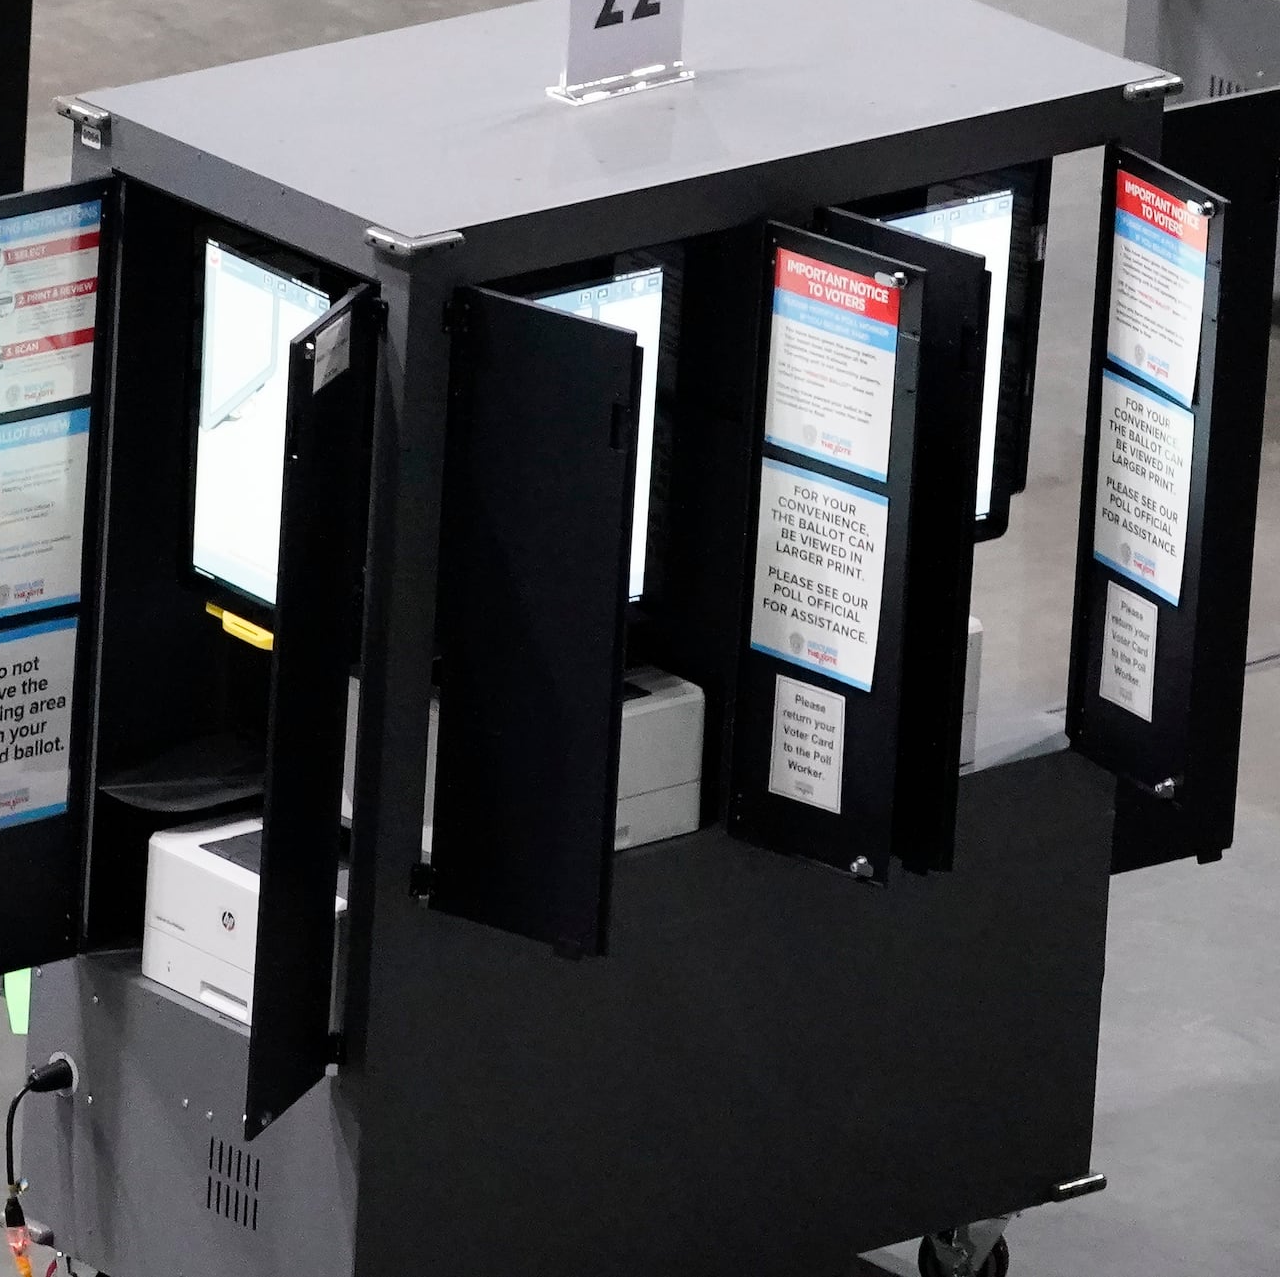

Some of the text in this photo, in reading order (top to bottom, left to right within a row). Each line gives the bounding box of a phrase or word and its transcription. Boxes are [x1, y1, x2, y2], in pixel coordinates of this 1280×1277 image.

[24, 206, 98, 233] INSTRUCTIONS
[1126, 181, 1200, 232] IMPORTANT NOTICE
[1142, 203, 1184, 238] TO VOTERS
[14, 246, 46, 261] SELECT
[27, 290, 51, 302] PRINT
[60, 281, 92, 296] REVIEW
[788, 260, 888, 303] IMPORTANT NOTICE
[808, 281, 865, 311] TO VOTERS
[15, 342, 39, 355] SCAN
[1126, 397, 1170, 428] FOR YOUR
[31, 419, 68, 437] REVIEW
[1109, 419, 1183, 468] THE BALLOT CAN
[1112, 451, 1146, 478] LARGER
[1116, 438, 1174, 478] BE VIEWED IN
[794, 485, 856, 516] FOR YOUR
[1106, 475, 1178, 524] PLEASE SEE OUR
[1110, 492, 1172, 537] POLL OFFICIAL
[771, 508, 874, 553] THE BALLOT CAN
[1102, 507, 1175, 557] FOR ASSISTANCE.
[781, 528, 862, 565] BE VIEWED IN
[776, 540, 864, 581] LARGER PRINT.
[768, 565, 868, 610] PLEASE SEE OUR
[774, 582, 860, 623] POLL OFFICIAL
[1121, 600, 1143, 621] Please
[763, 597, 865, 643] FOR ASSISTANCE.
[1112, 629, 1148, 658] Voter Card
[1135, 627, 1150, 643] your
[13, 656, 39, 676] not
[1133, 658, 1146, 673] Poll
[22, 677, 48, 695] the
[30, 696, 66, 715] area
[795, 694, 826, 714] Please
[12, 721, 47, 744] your
[783, 709, 835, 734] return your
[14, 736, 65, 761] ballot.
[783, 724, 834, 750] Voter Card
[784, 741, 831, 766] to the Poll
[787, 759, 823, 779] Worker.
